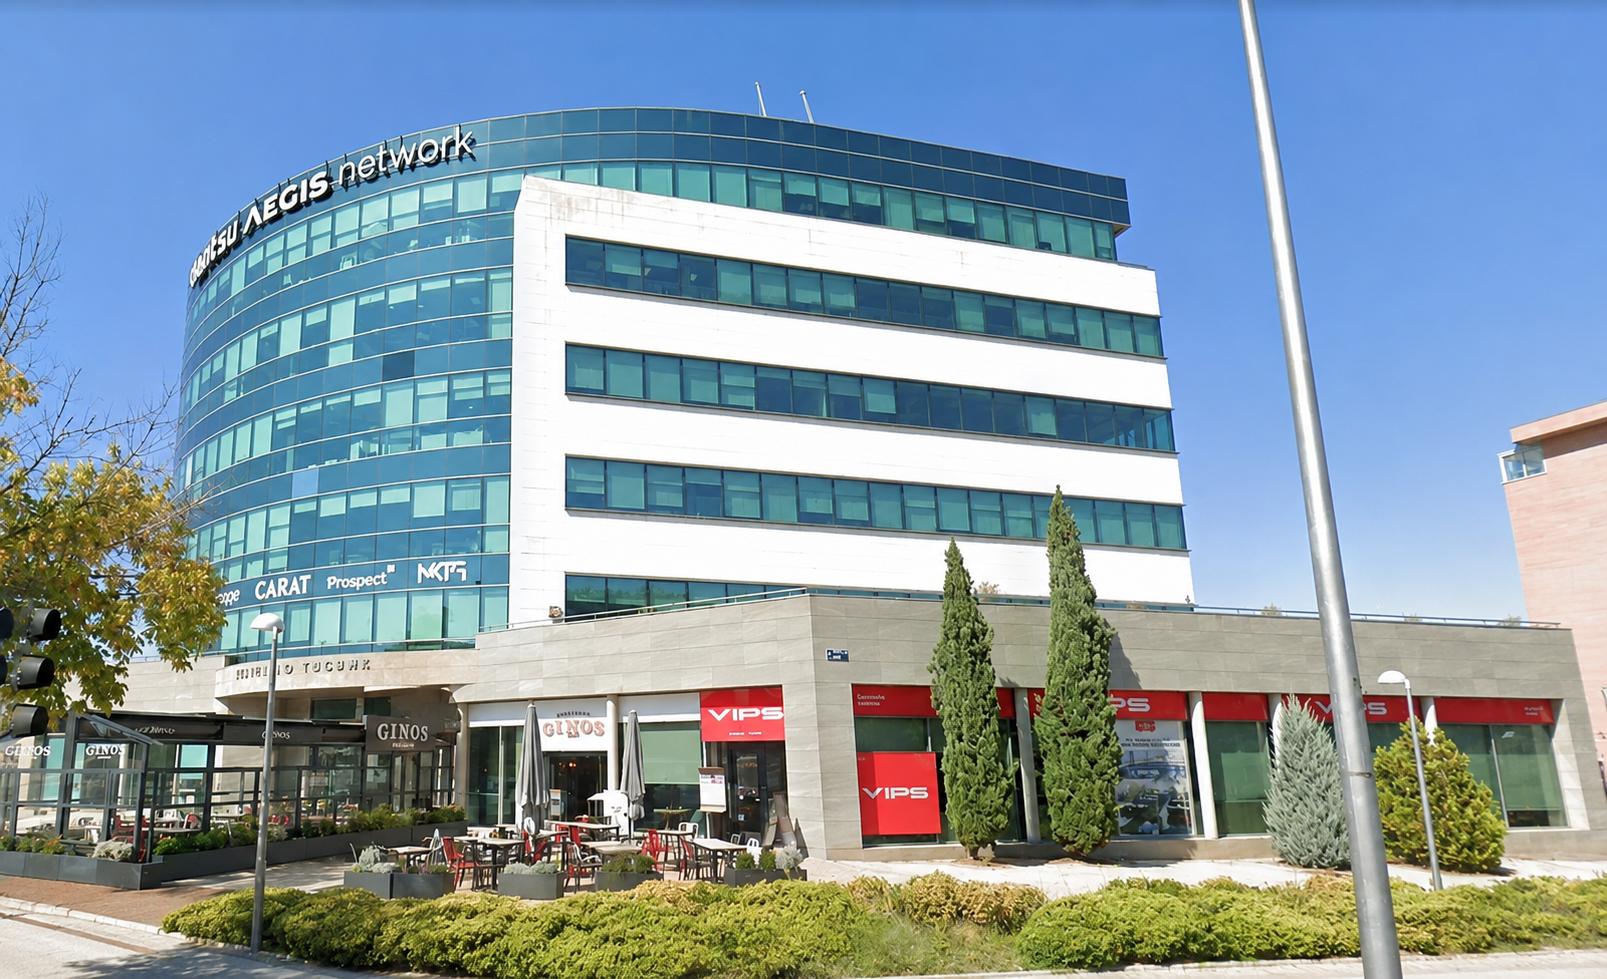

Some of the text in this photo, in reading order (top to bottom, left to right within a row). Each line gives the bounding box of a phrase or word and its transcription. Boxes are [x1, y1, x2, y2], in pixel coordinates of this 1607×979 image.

[338, 126, 475, 187] network
[254, 574, 312, 600] CARAT
[326, 571, 388, 590] Prospect
[707, 706, 785, 722] VIPS
[1314, 701, 1388, 715] VS
[261, 730, 291, 740] GNOS
[377, 722, 429, 742] GINOS
[542, 719, 605, 738] GINOS
[85, 743, 126, 756] GINOS
[861, 786, 929, 800] VIPS
